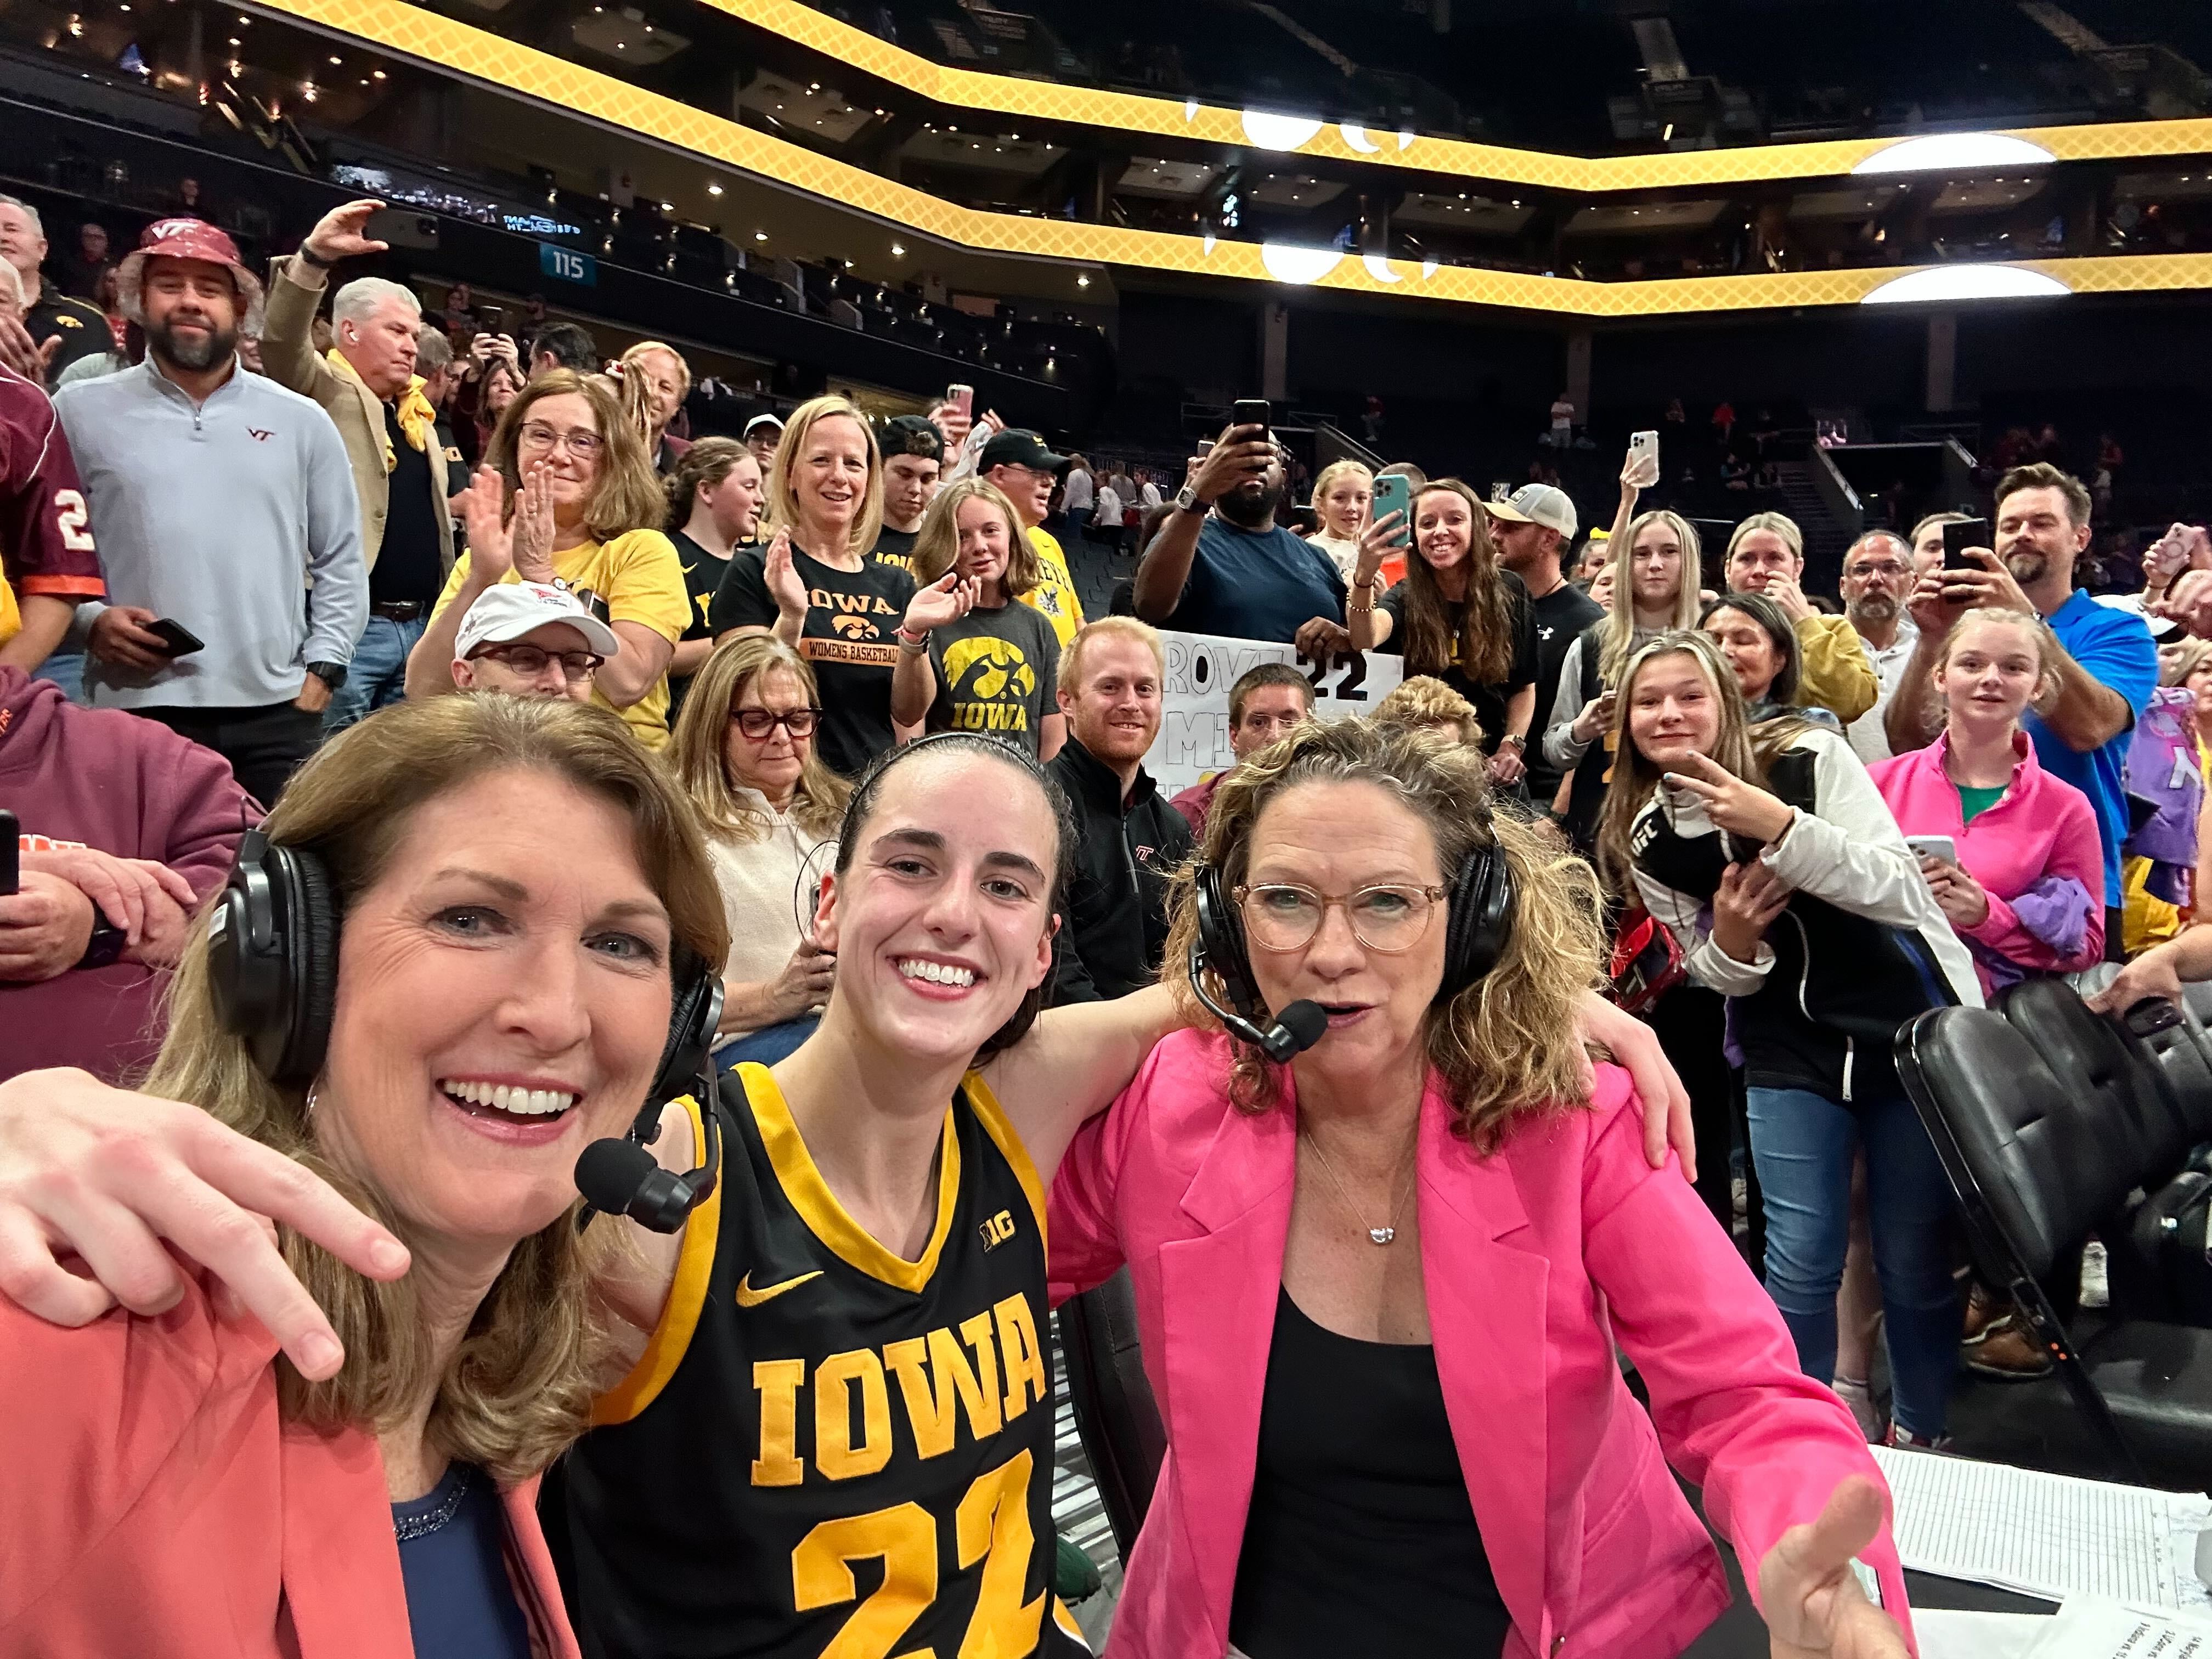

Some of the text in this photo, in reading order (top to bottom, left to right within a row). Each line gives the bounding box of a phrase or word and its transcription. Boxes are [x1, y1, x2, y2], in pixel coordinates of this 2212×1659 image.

[152, 222, 199, 239] VT
[554, 251, 583, 279] 115
[245, 426, 276, 441] VT
[806, 589, 900, 615] OWA
[809, 641, 847, 659] WOMENS
[1296, 651, 1368, 701] 22
[951, 702, 1028, 731] IOWA
[751, 1292, 1047, 1486] IOWA
[792, 1448, 1047, 1659] 22
